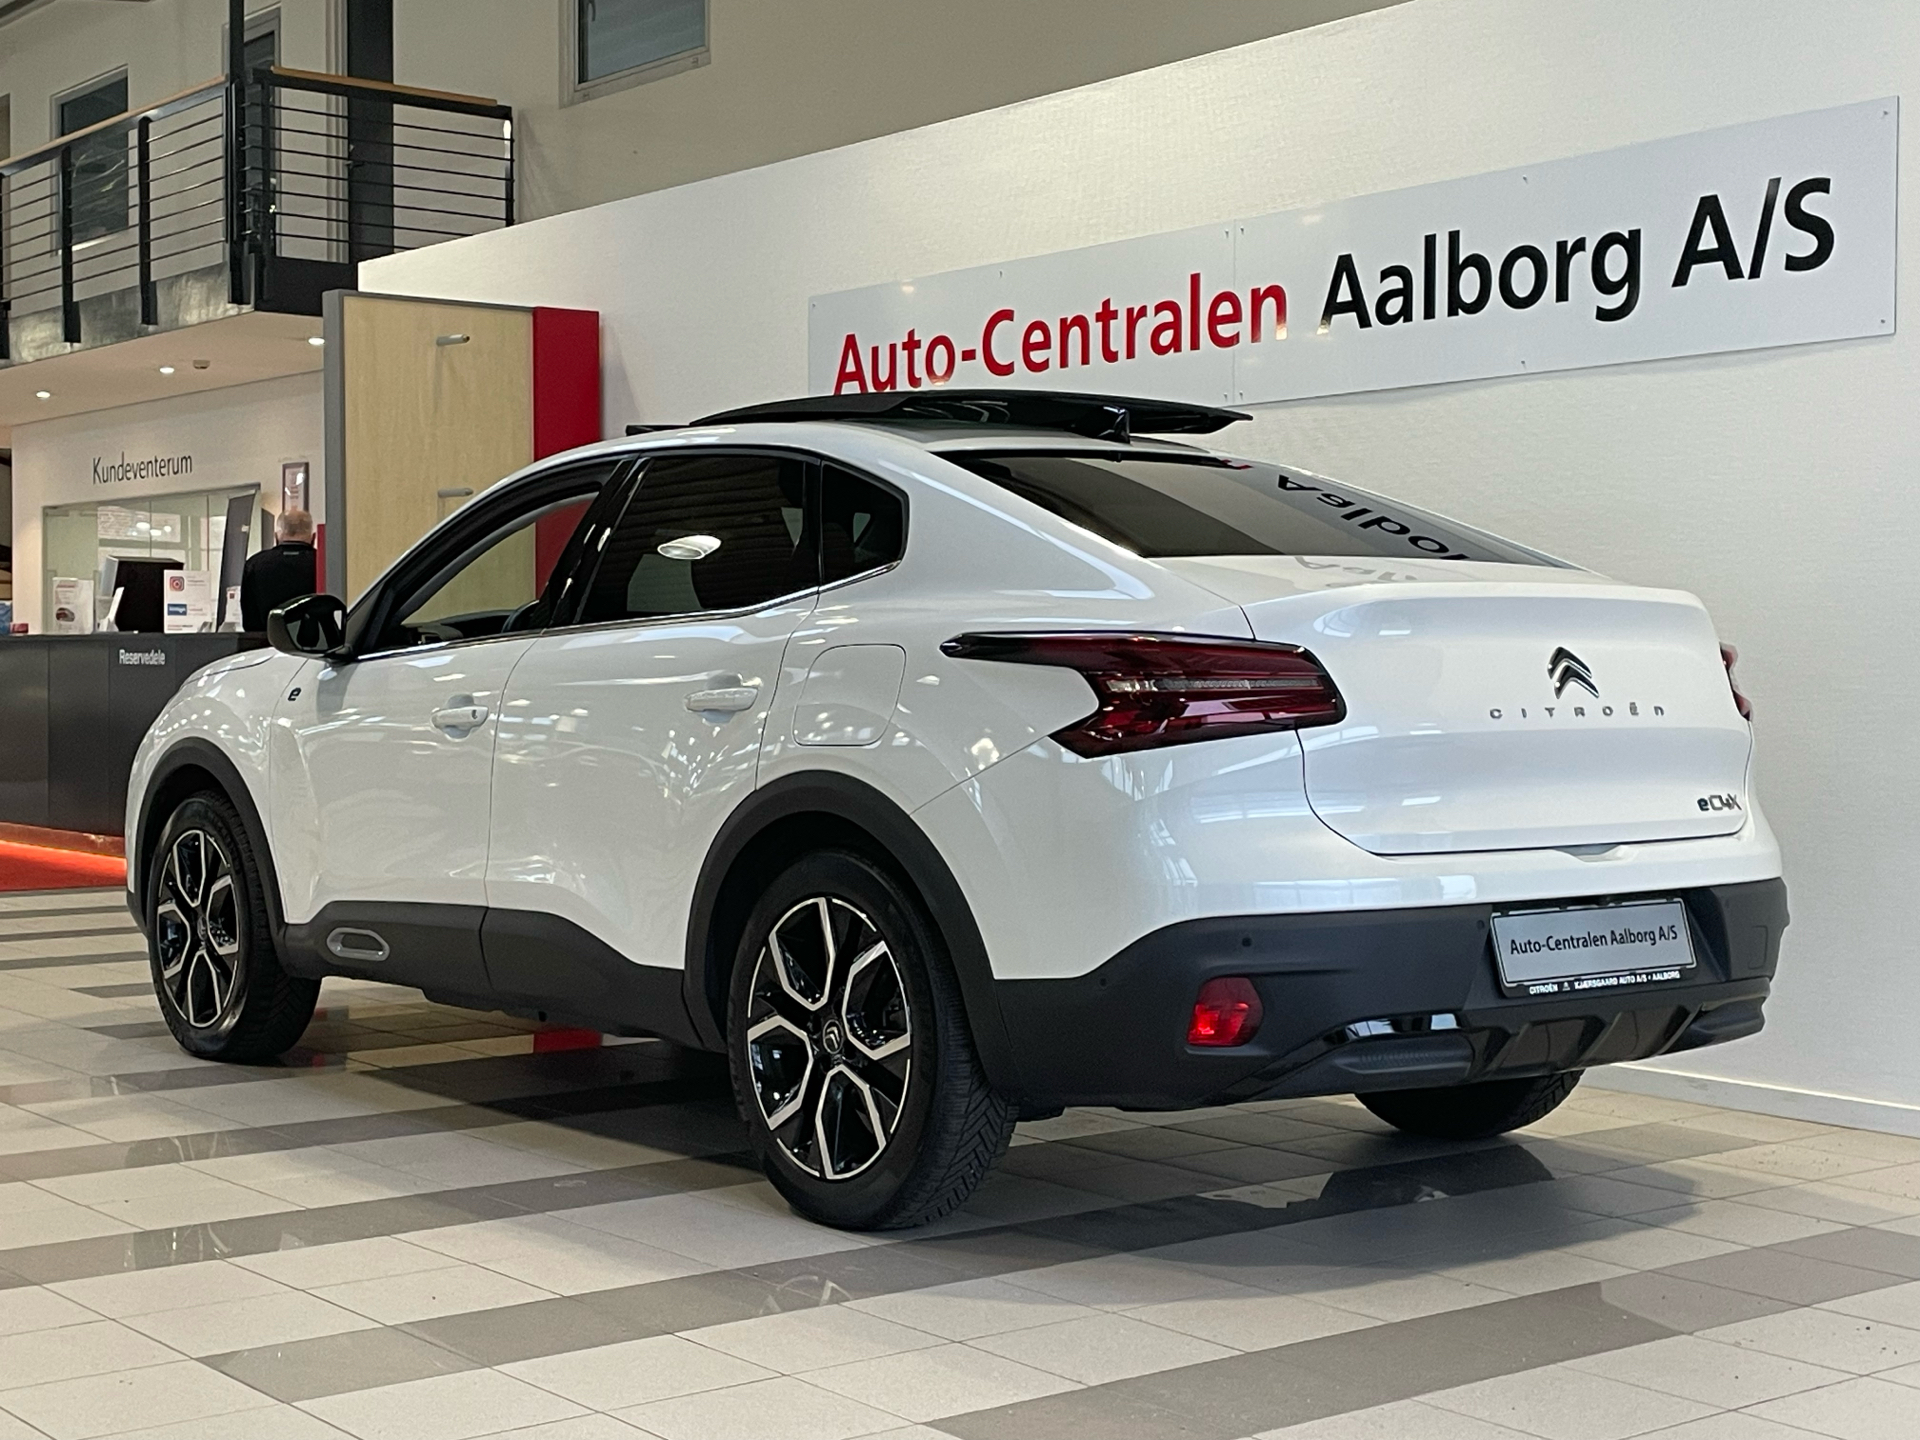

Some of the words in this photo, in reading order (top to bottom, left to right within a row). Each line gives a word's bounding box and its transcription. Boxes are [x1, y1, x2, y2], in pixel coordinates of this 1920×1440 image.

[835, 274, 1288, 395] Auto-Centralen
[1317, 228, 1642, 327] Aalborg
[1673, 175, 1835, 288] A/S
[93, 451, 192, 485] Kundeventerum
[119, 649, 165, 667] Reservedele
[1510, 931, 1608, 955] Auto-Centralen
[1610, 928, 1656, 947] Aalborg
[1658, 924, 1678, 941] A/S
[1619, 975, 1635, 985] AUTO
[1652, 970, 1680, 981] AALBORG
